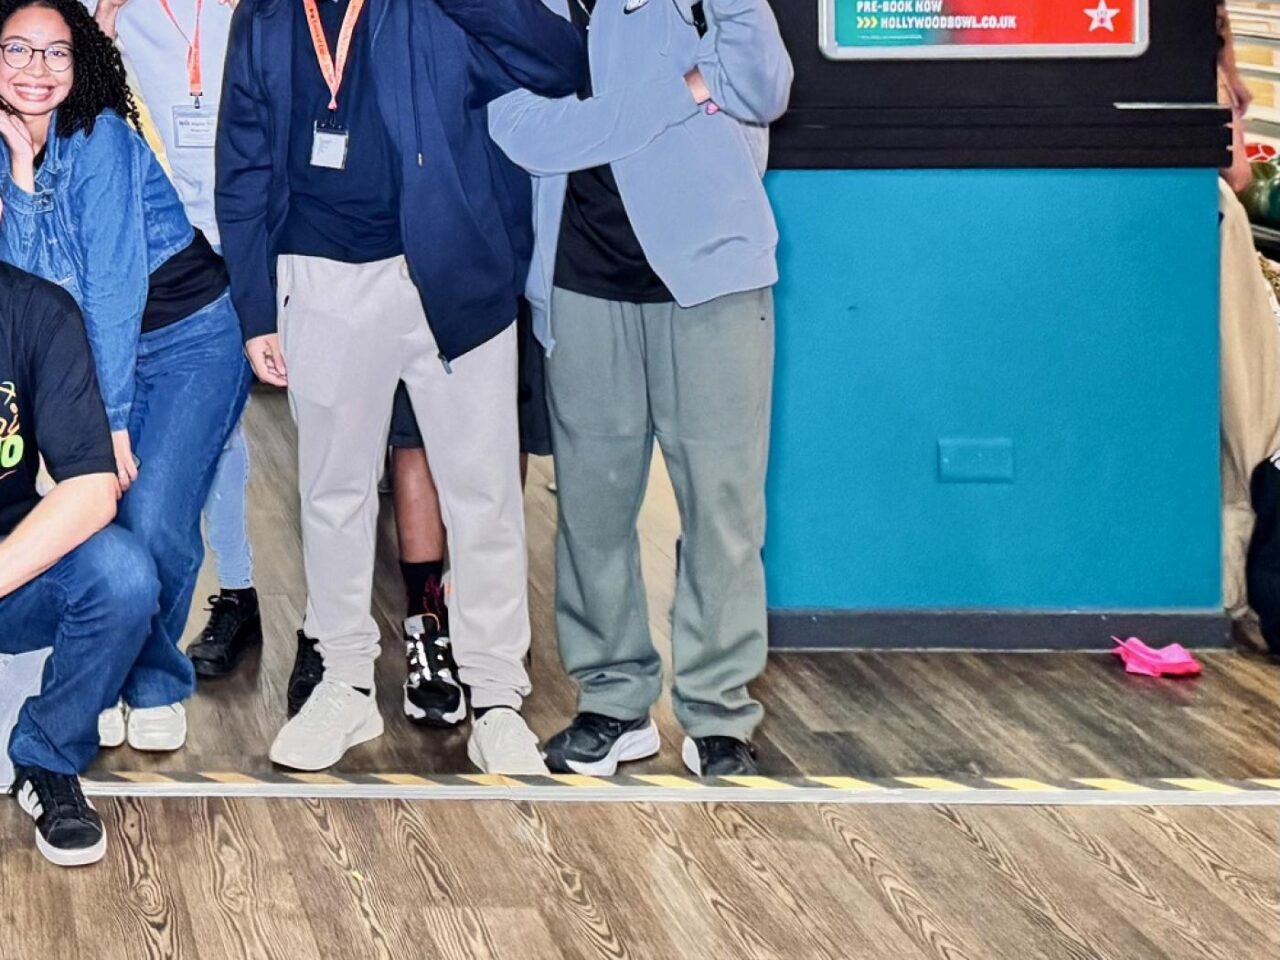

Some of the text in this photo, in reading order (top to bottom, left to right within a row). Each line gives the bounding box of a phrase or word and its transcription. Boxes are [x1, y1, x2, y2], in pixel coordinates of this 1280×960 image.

[856, 0, 943, 13] PRE-BOOK NOW
[880, 16, 1017, 29] HOLLYWOODBOWL.CO.UK
